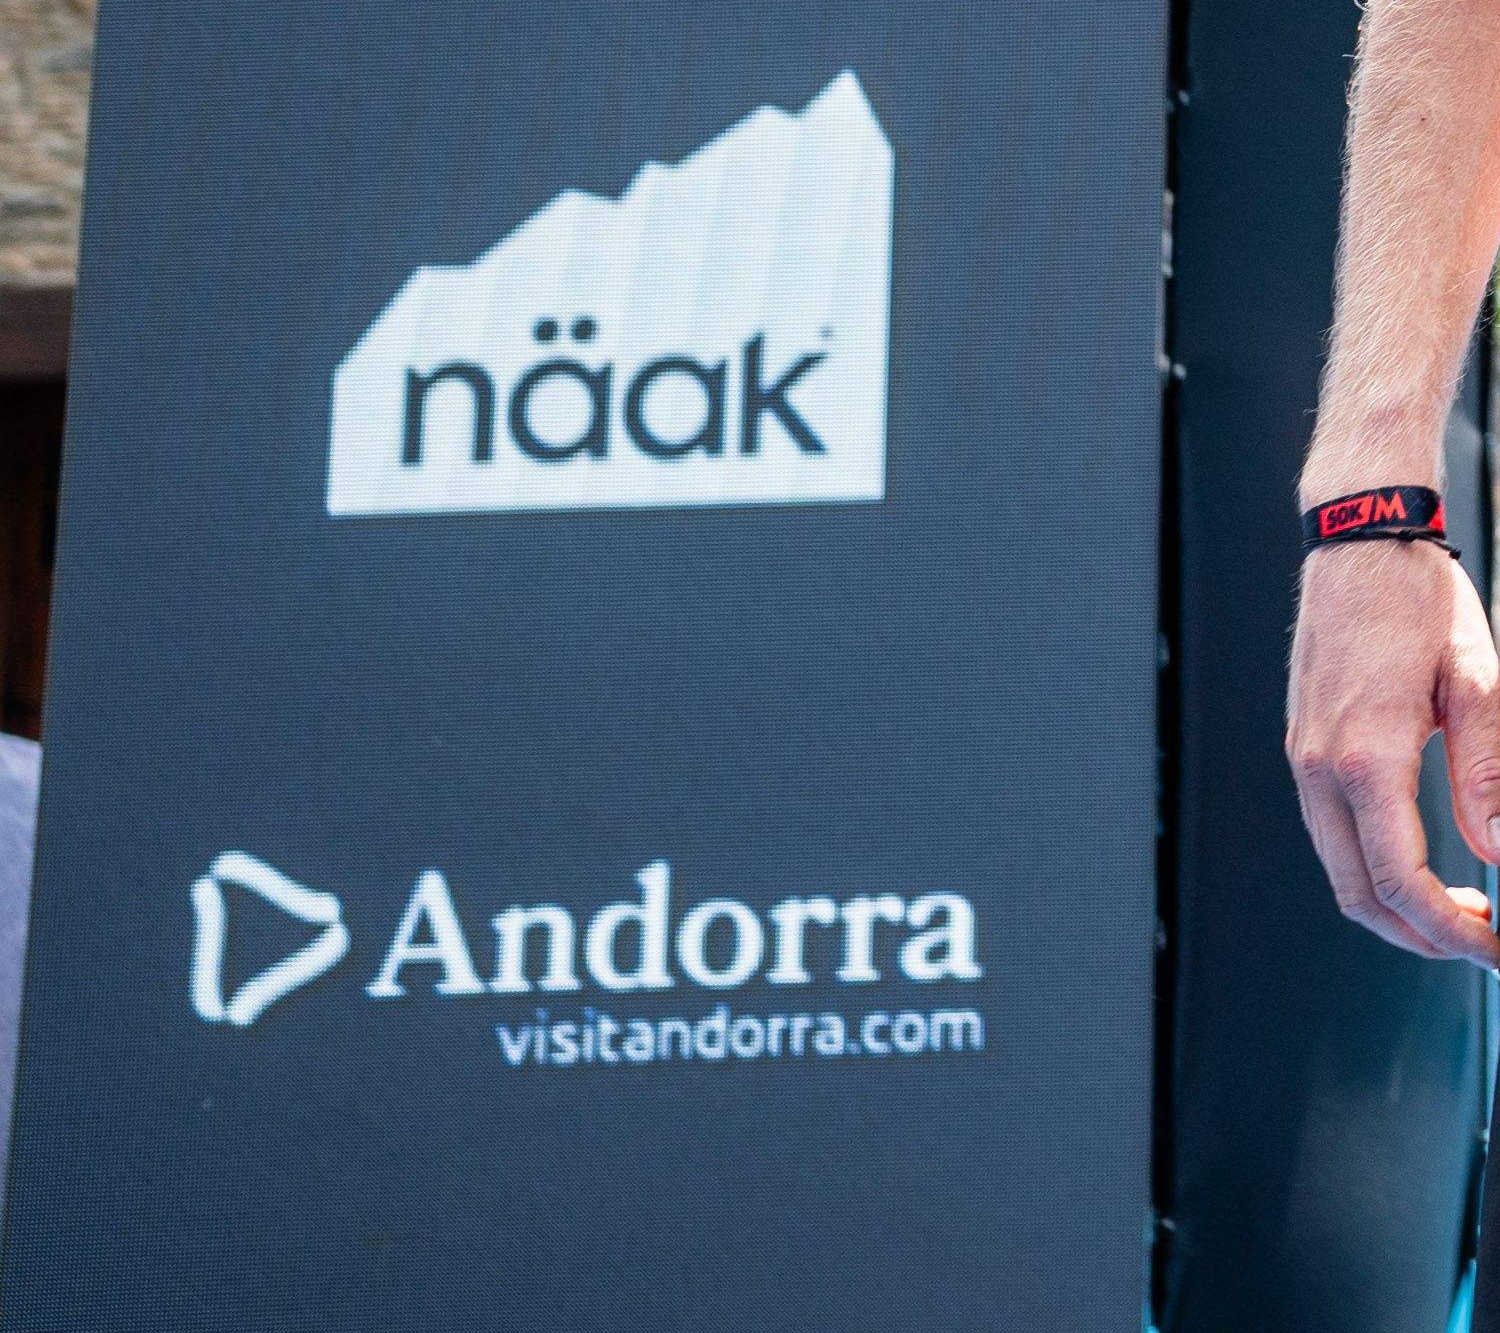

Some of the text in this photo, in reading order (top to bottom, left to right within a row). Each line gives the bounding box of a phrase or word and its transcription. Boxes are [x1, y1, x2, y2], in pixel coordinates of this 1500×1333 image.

[401, 316, 830, 468] näak
[1325, 505, 1366, 532] 50K
[364, 859, 982, 997] Andorra
[495, 1003, 985, 1069] visitandorra.com
